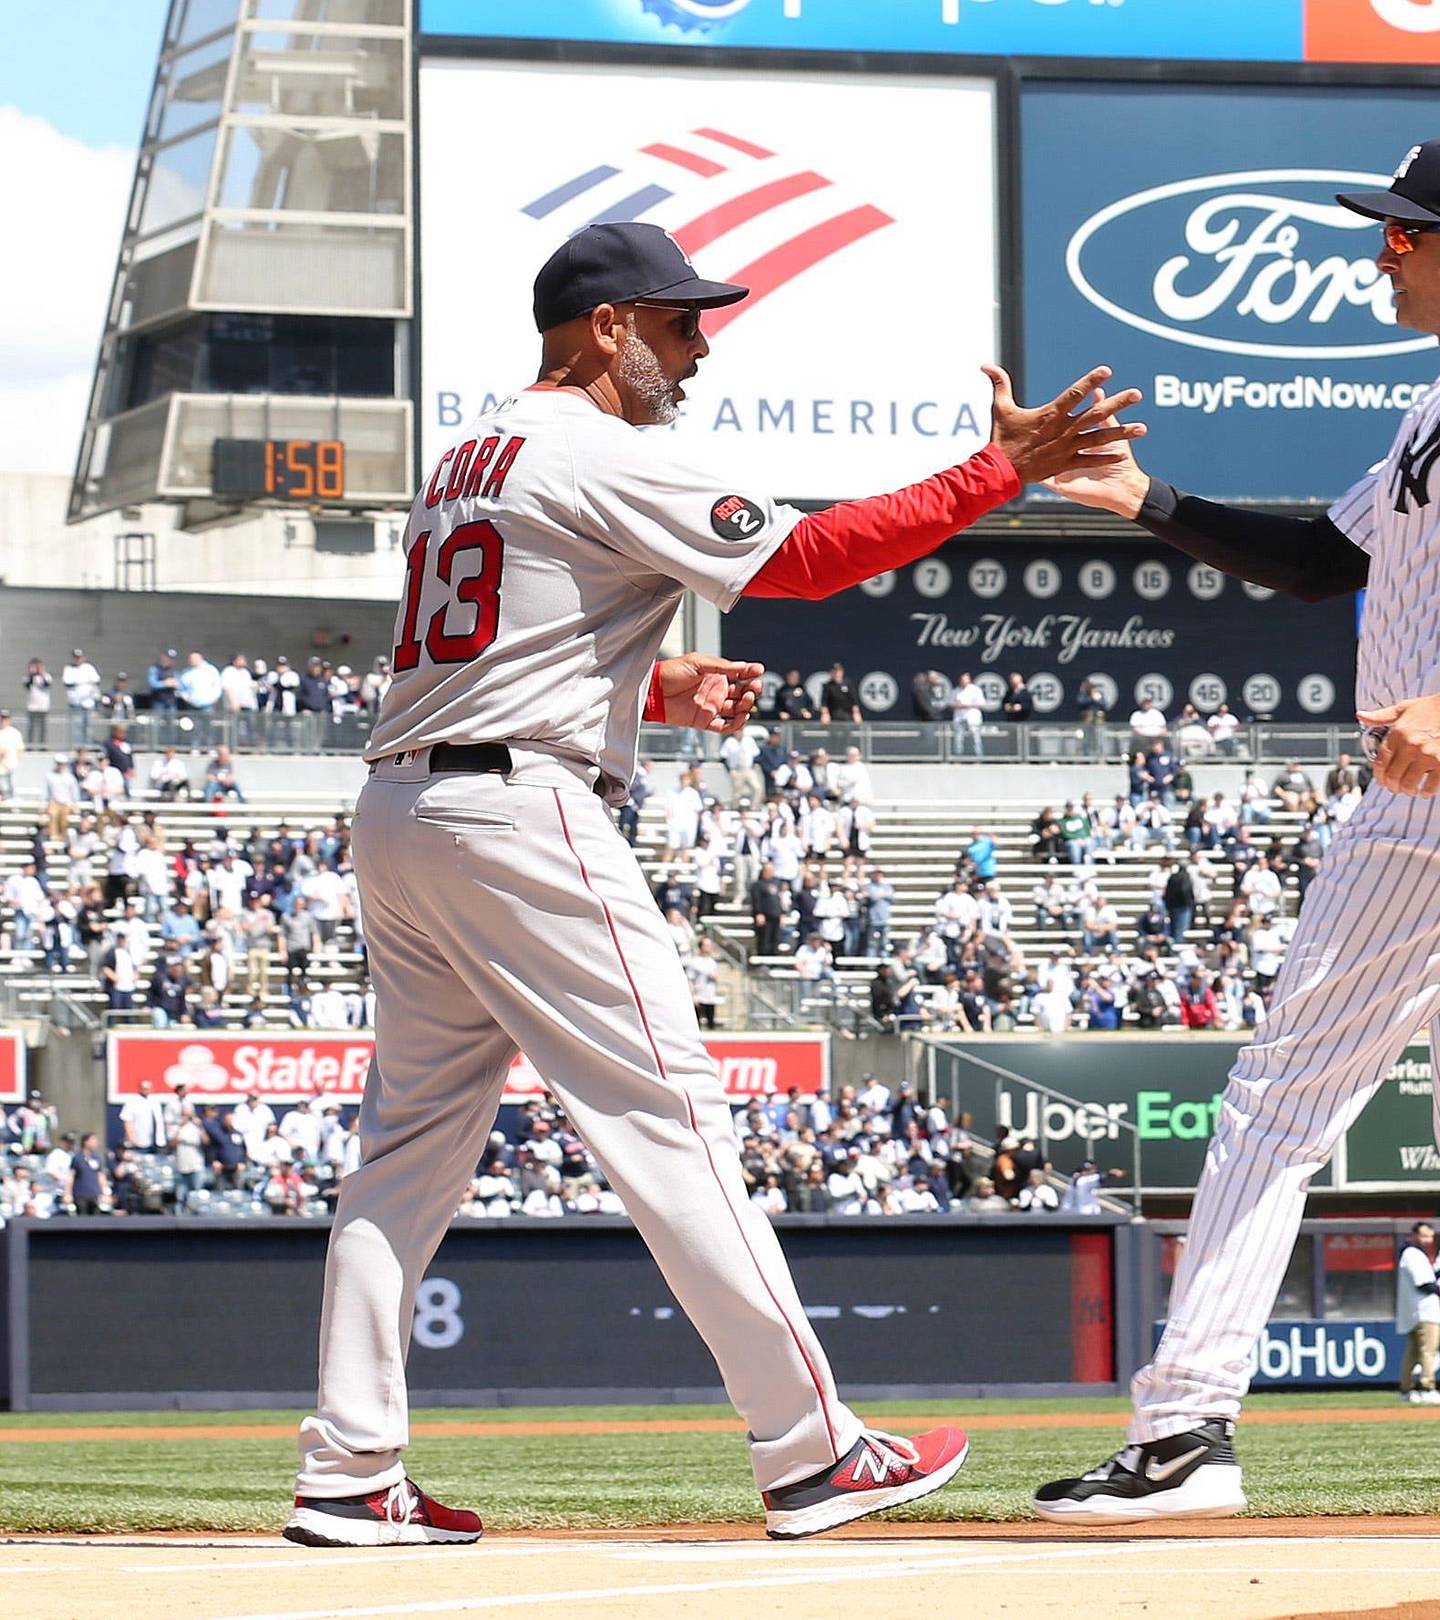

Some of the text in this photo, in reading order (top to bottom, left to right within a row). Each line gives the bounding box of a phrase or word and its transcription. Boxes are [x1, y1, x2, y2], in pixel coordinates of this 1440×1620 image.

[712, 396, 982, 438] AMERICA
[264, 440, 345, 497] 1:58
[425, 435, 527, 510] CORA
[731, 509, 760, 533] 2
[393, 518, 505, 673] 13
[974, 569, 1001, 589] 37
[910, 613, 1176, 665] New York Yankees
[863, 684, 889, 702] 44
